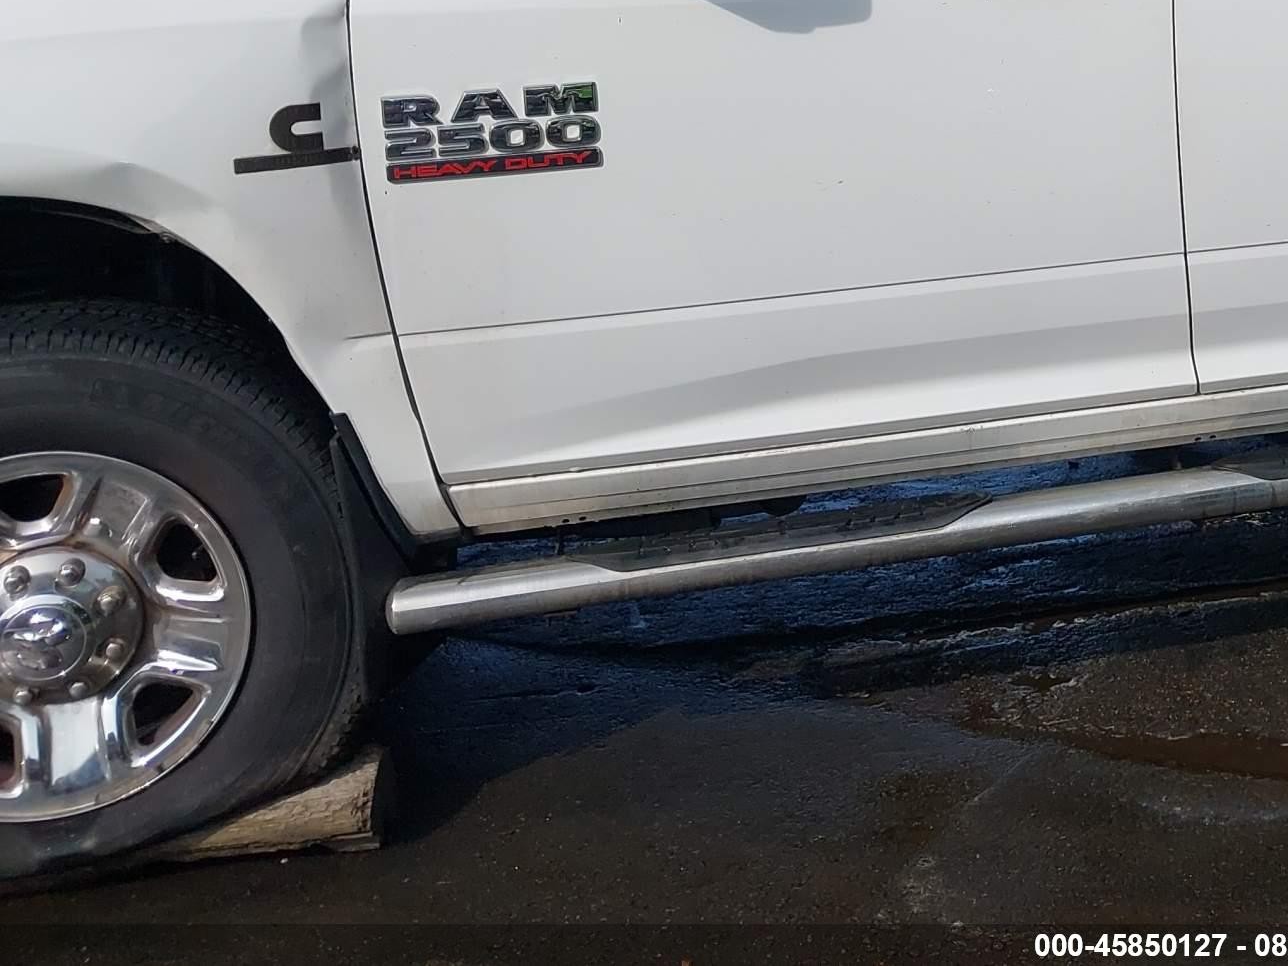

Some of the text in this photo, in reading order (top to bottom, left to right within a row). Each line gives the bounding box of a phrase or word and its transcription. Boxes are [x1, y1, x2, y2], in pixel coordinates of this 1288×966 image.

[381, 82, 599, 127] RAM
[384, 115, 602, 162] 2500
[393, 150, 592, 180] HEAVY DUTY
